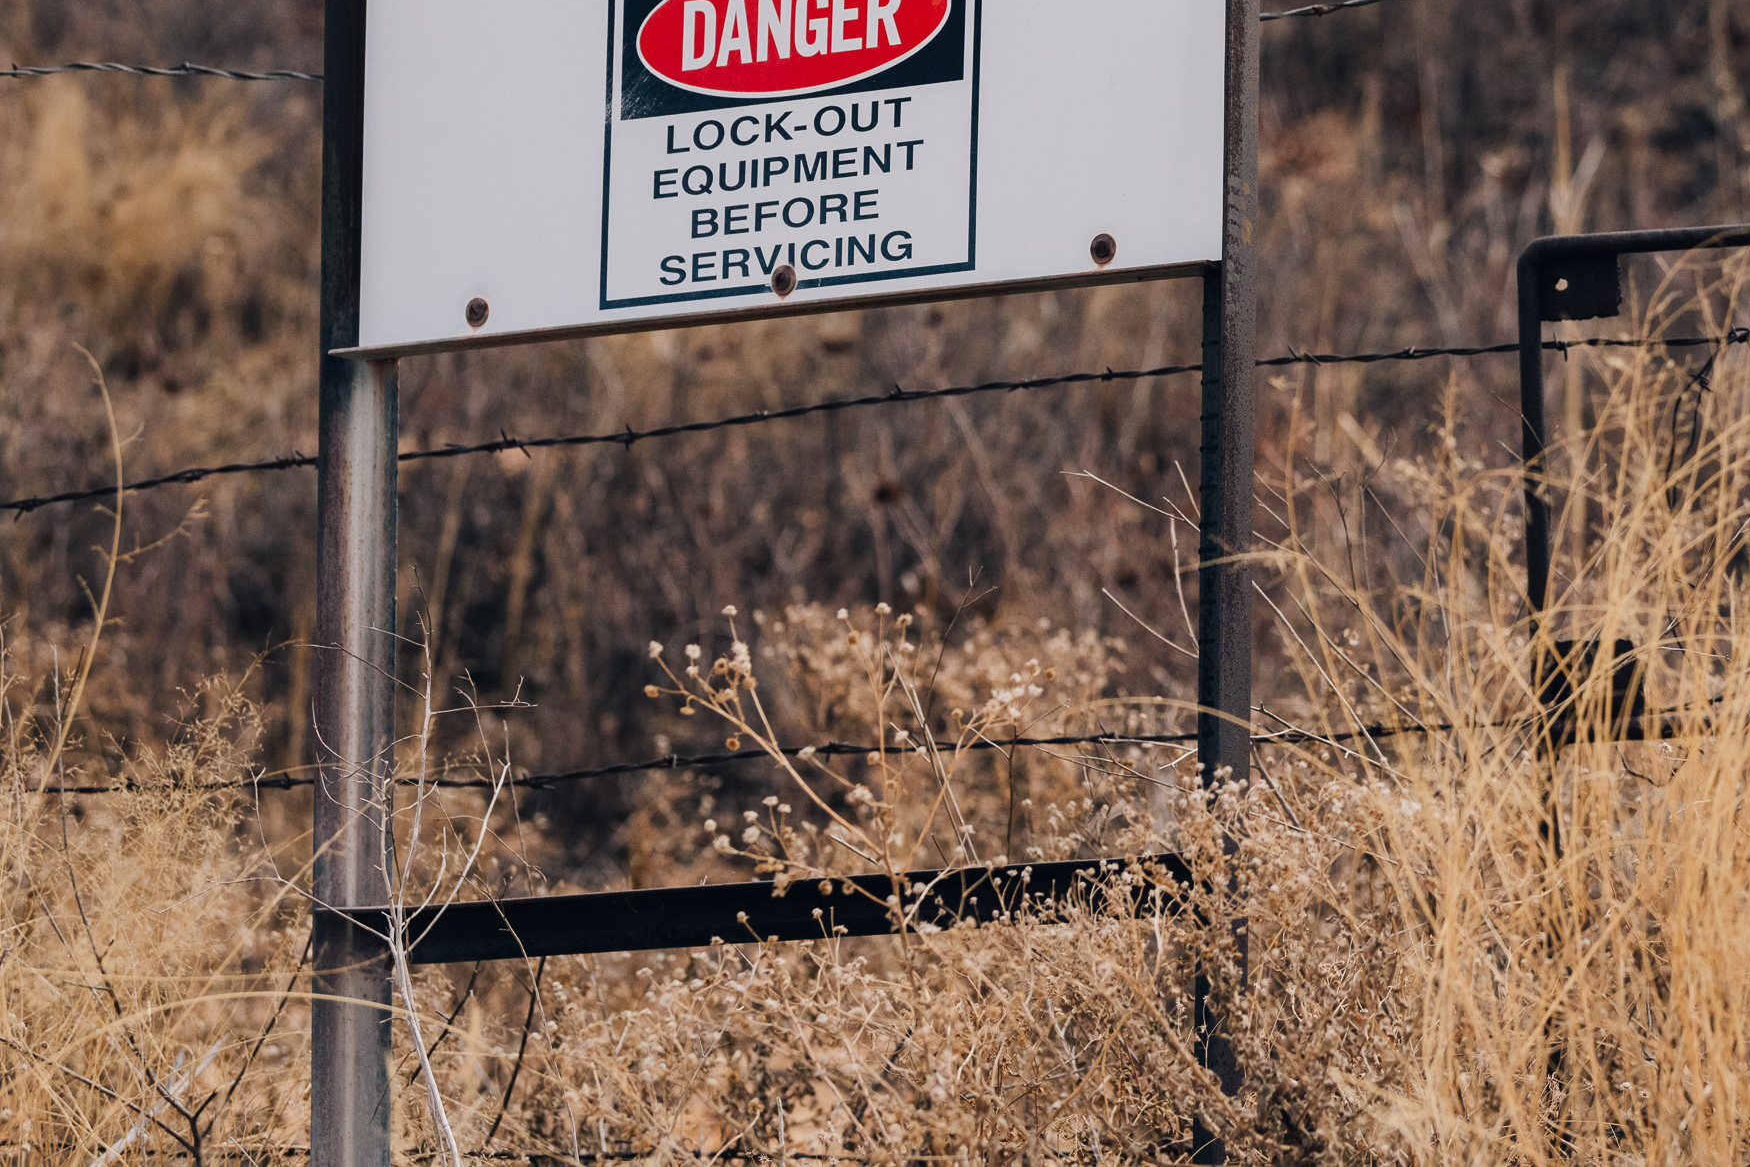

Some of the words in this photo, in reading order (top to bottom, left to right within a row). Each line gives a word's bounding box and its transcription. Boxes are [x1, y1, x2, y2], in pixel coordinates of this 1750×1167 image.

[665, 95, 912, 155] LOCK-OUT
[652, 139, 925, 200] EQUIPMENT
[690, 188, 880, 240] BEFORE
[658, 229, 914, 287] SERVICING
